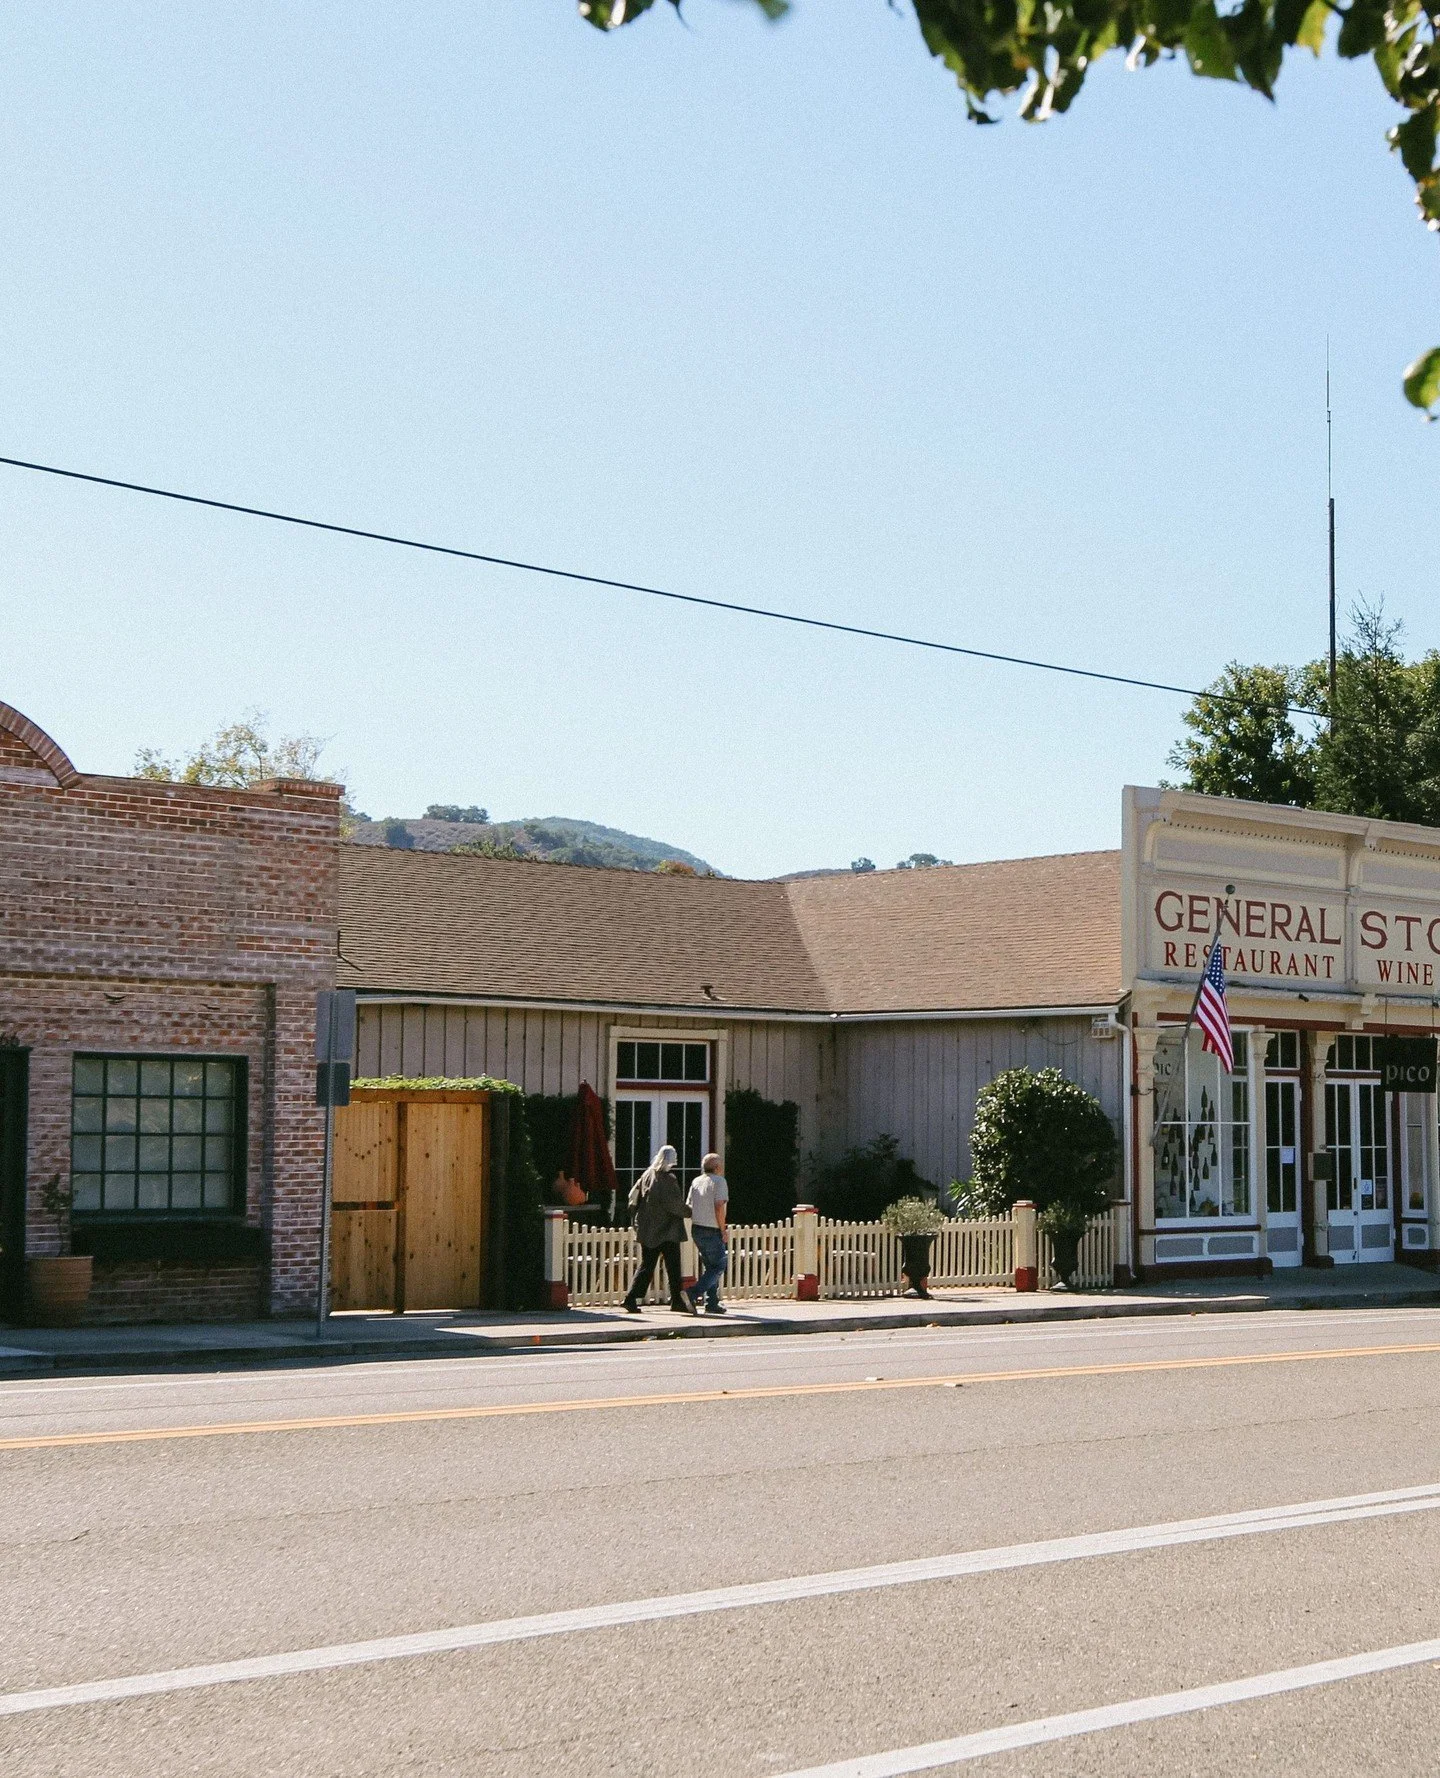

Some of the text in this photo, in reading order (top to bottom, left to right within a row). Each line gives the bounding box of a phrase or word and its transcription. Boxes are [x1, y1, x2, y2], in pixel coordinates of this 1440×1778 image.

[1154, 890, 1342, 945] GENERAL
[1164, 941, 1434, 986] RESTAURANT WINE
[1385, 1065, 1430, 1085] pico
